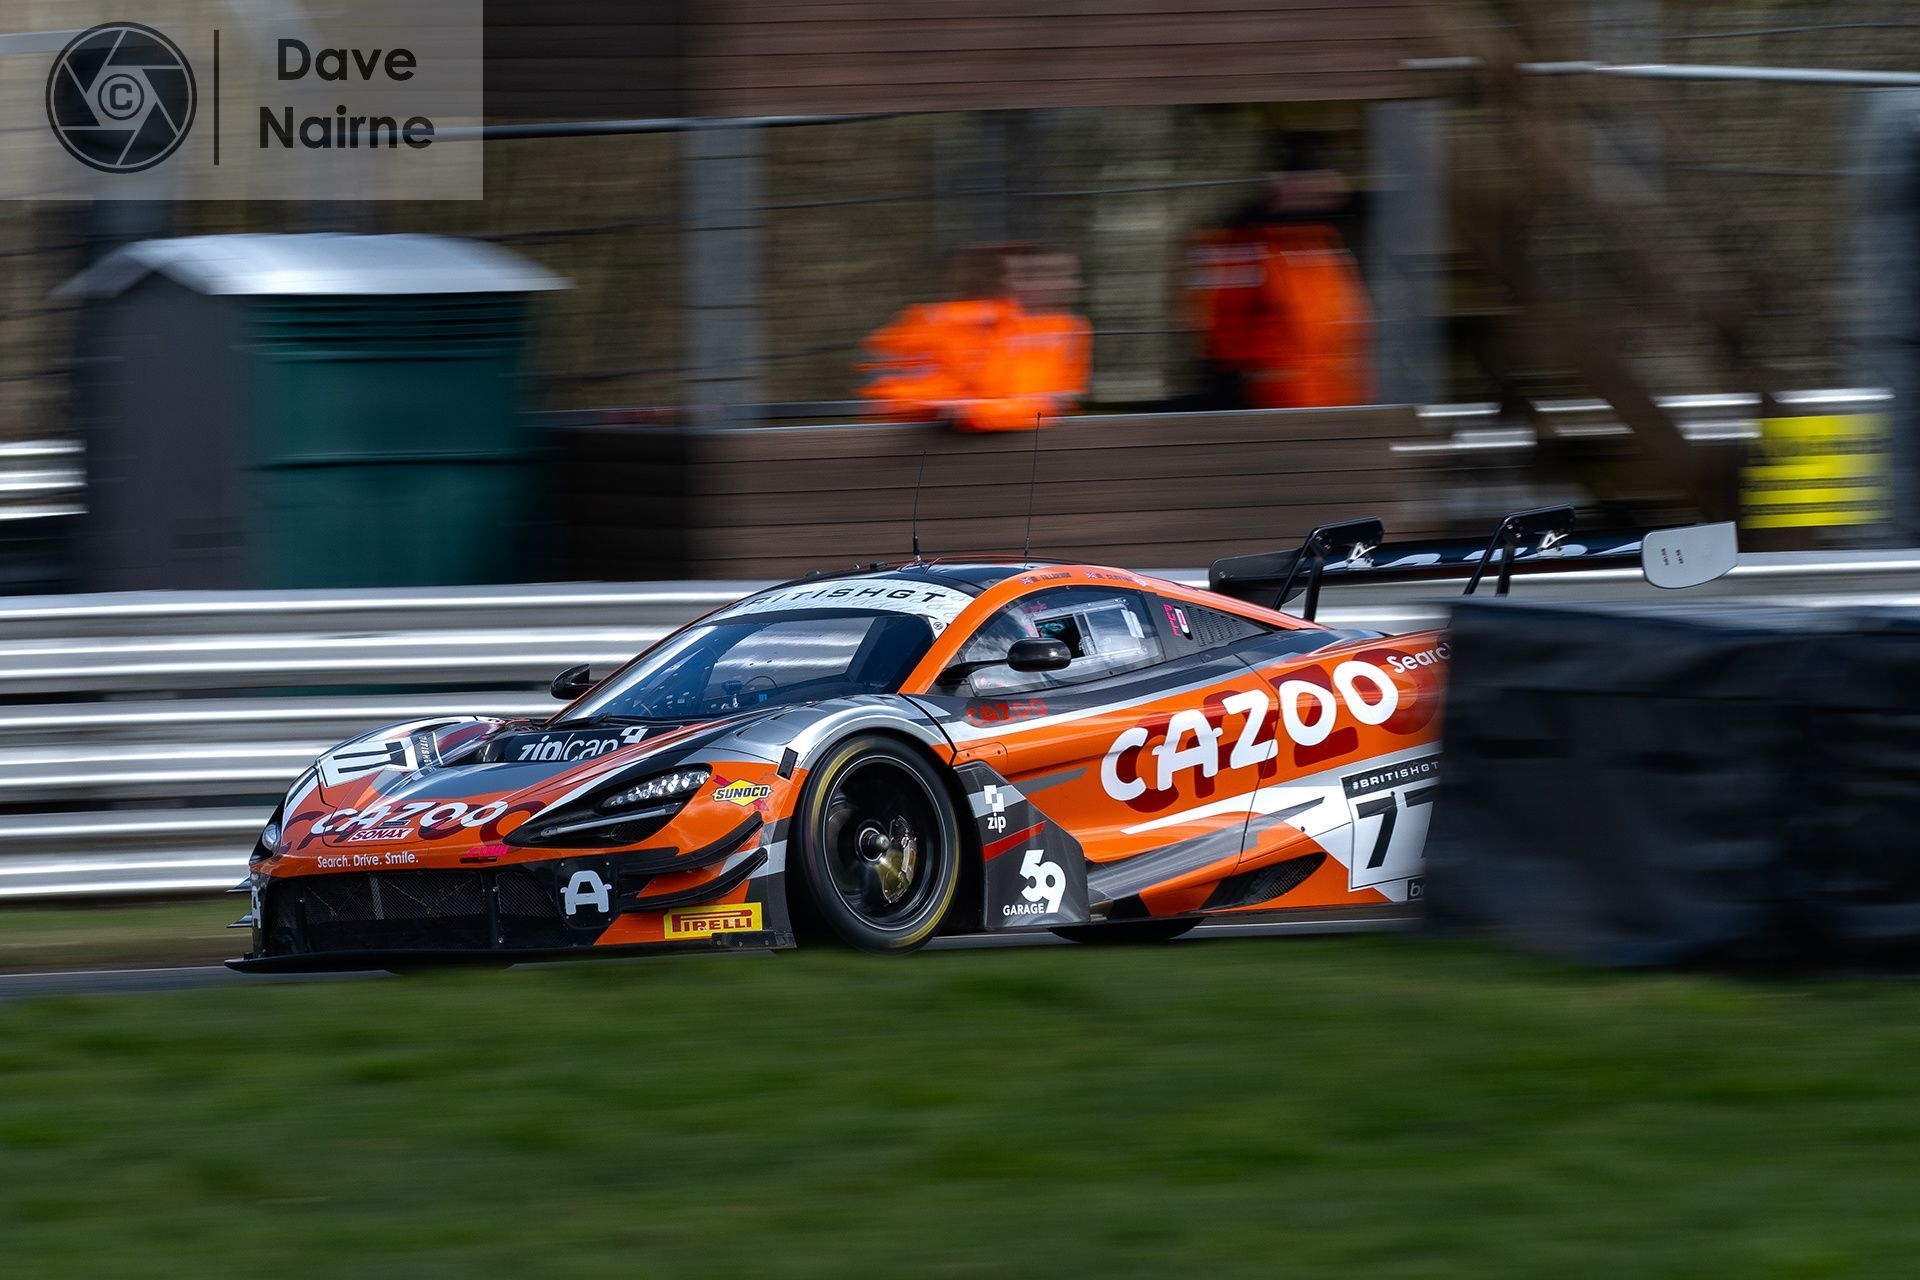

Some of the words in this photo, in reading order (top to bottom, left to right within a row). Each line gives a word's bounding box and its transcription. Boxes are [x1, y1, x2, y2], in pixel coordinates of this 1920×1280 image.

[1386, 642, 1451, 674] Searc
[966, 699, 1048, 727] CAZOO
[1101, 660, 1399, 801] CAZOO
[716, 786, 769, 799] SUNOCO
[311, 801, 508, 834] CAZOO
[987, 812, 1007, 833] zip
[352, 828, 407, 841] SONAX
[317, 856, 351, 868] Search.
[353, 854, 382, 867] Drive.
[385, 850, 419, 865] Smile.
[1019, 849, 1066, 913] 59
[672, 909, 752, 932] PIRELLI
[1003, 903, 1044, 915] GARAGE
